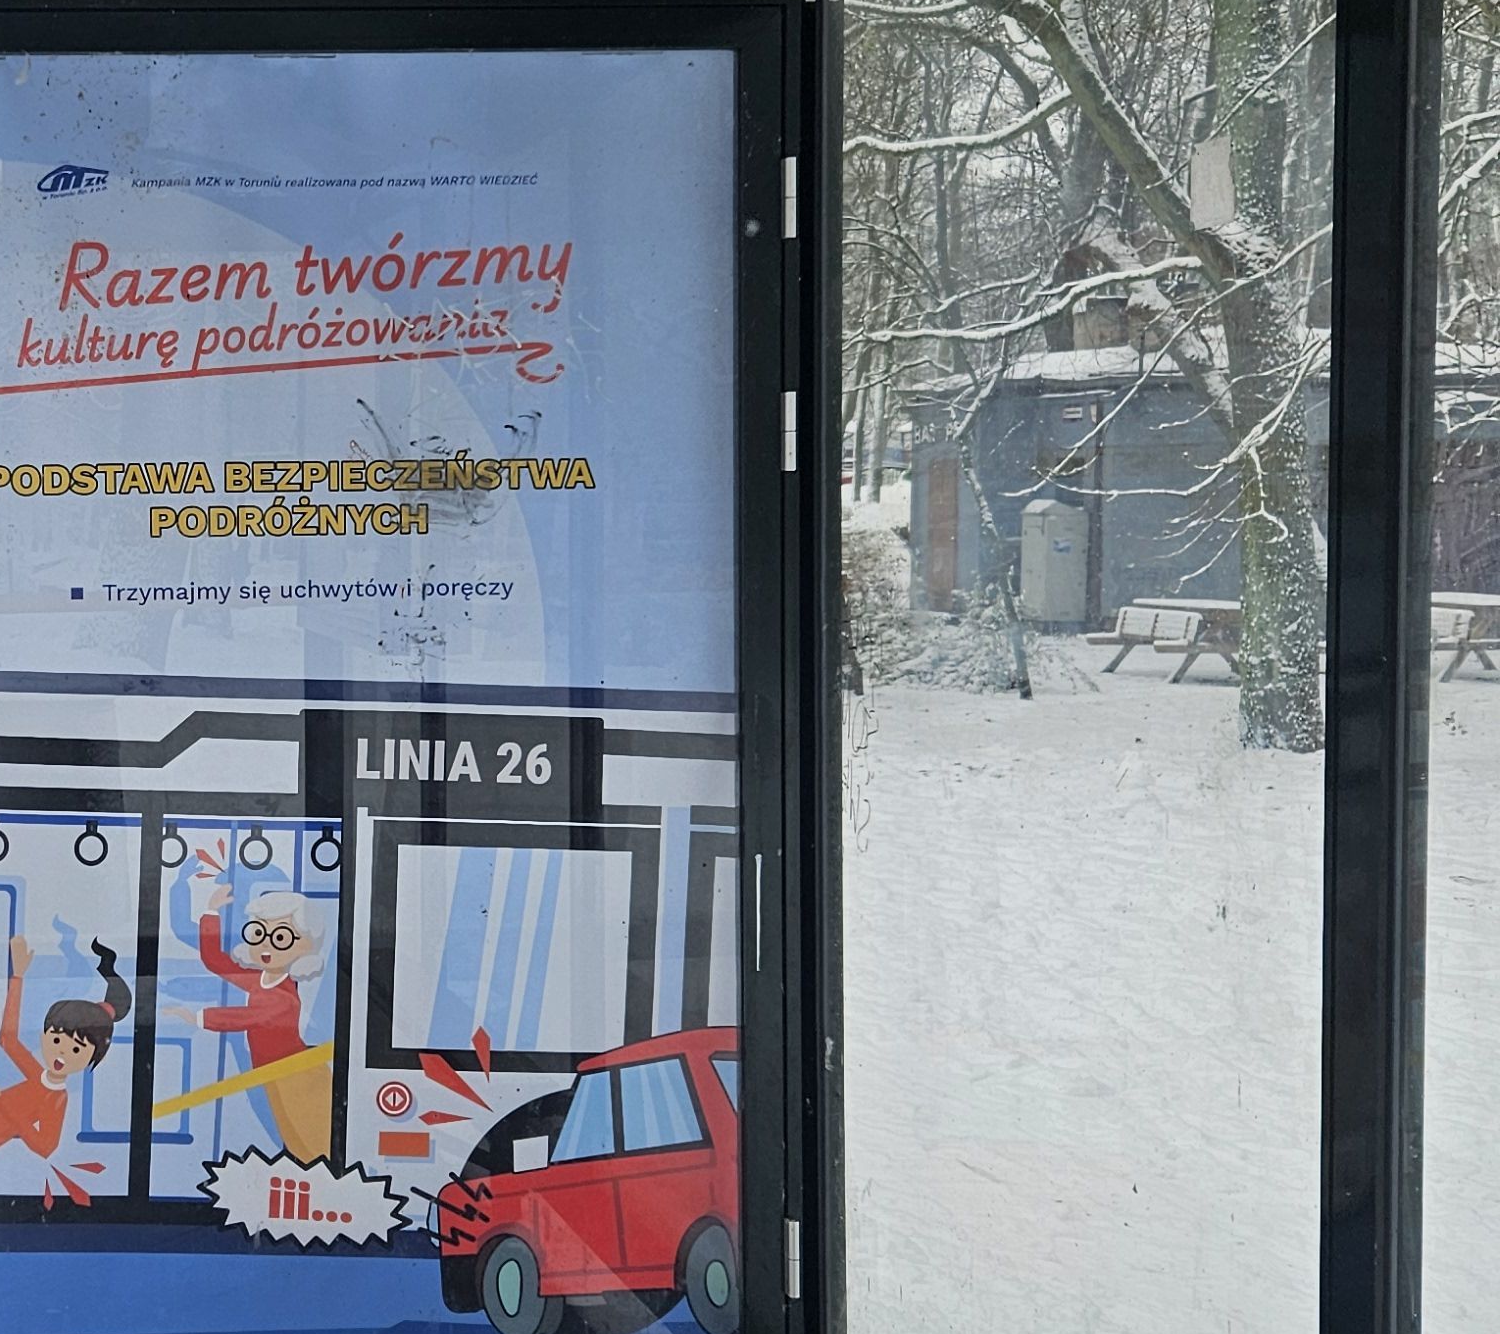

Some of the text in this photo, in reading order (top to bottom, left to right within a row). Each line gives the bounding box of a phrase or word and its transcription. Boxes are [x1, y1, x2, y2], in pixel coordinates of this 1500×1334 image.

[131, 177, 191, 189] Kampania
[195, 176, 222, 187] MZK
[239, 176, 282, 187] Toruniu
[284, 175, 357, 188] realizowana
[360, 175, 384, 189] pod
[387, 177, 426, 189] nazwą
[430, 175, 476, 186] WARTO
[480, 172, 539, 186] WIEDZIEĆ
[59, 233, 573, 314] Razem twórzmy
[16, 300, 511, 371] kulturę podróżowania
[224, 450, 596, 493] BEZPIECZEŃSTWA
[149, 496, 429, 537] PODRÓŻNYCH
[102, 579, 515, 605] Trzymajmy się uchwytów i poręczy
[356, 738, 552, 785] LINIA 26
